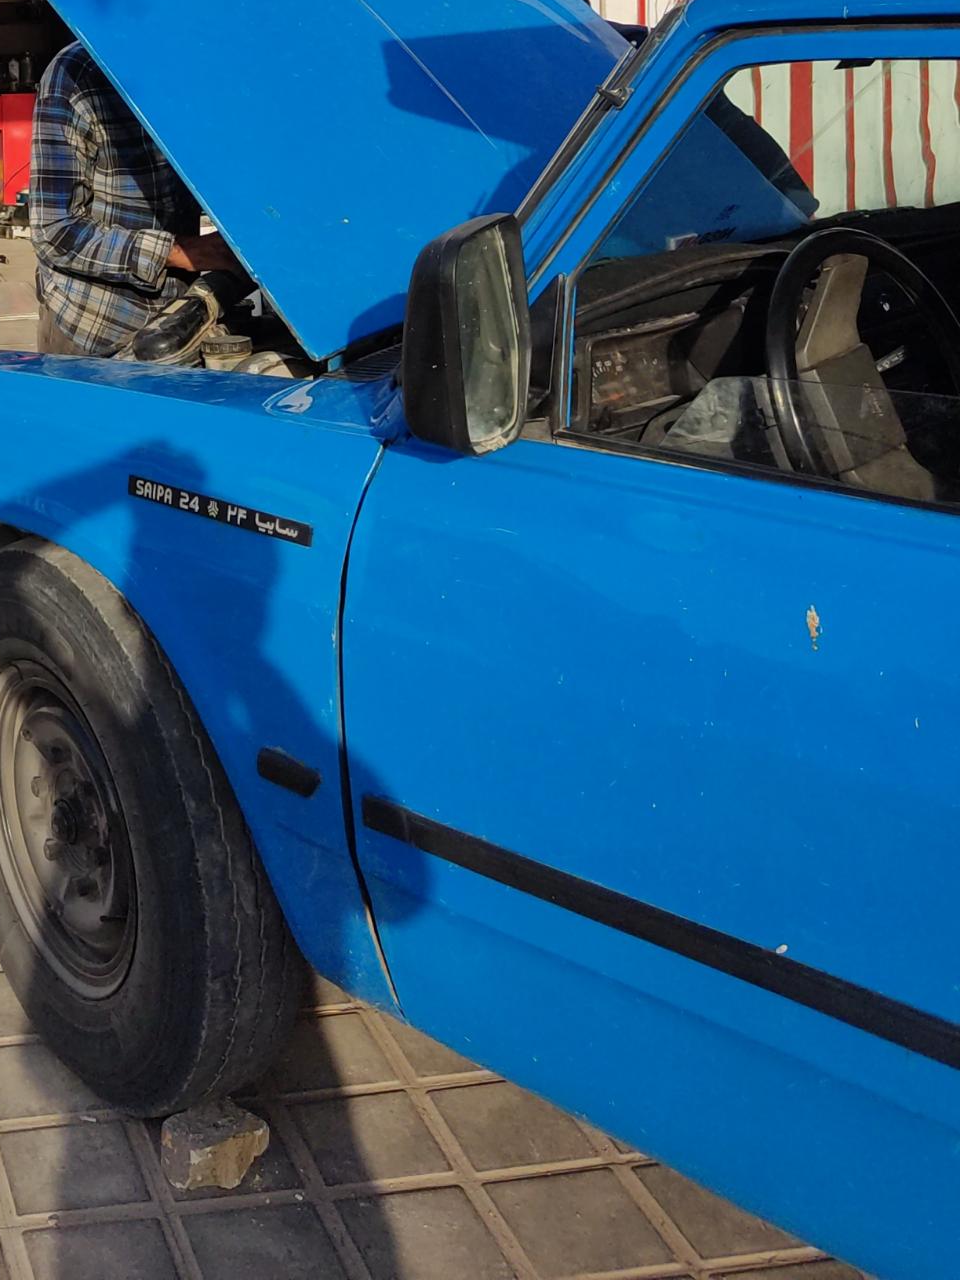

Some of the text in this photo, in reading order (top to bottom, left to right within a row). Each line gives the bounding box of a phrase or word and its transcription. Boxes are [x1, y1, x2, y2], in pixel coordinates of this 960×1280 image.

[135, 479, 200, 513] SAIPA 24
[227, 504, 299, 539] سایپا ۲۴
